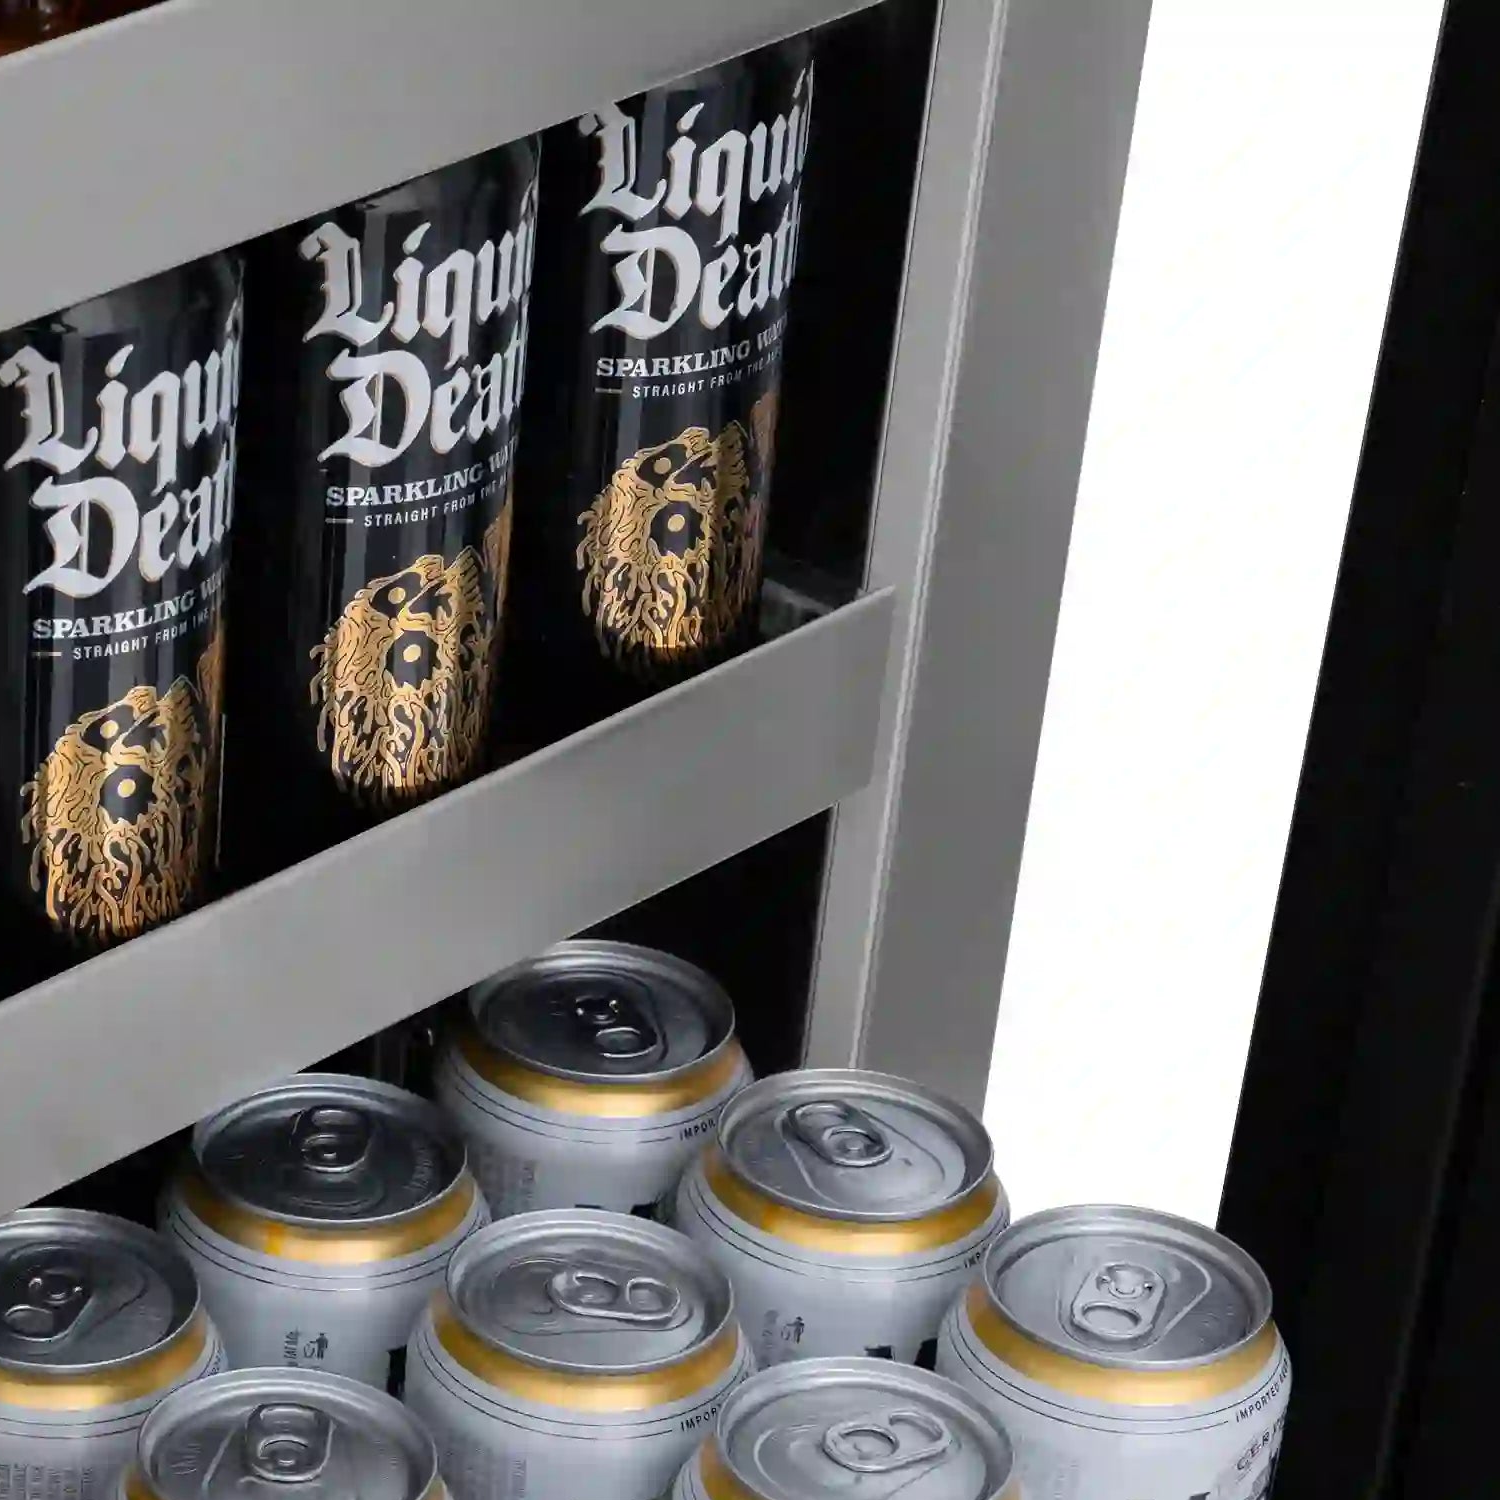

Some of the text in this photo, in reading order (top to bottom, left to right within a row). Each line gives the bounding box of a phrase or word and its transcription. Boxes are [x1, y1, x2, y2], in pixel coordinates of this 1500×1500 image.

[596, 340, 750, 377] SPARKLING
[633, 379, 705, 398] STRAIGHT
[711, 368, 742, 388] FROM
[326, 462, 483, 507] SPARKLING
[364, 506, 438, 528] STRAIGHT
[444, 493, 475, 515] FROM
[32, 593, 196, 640] SPARKLING
[73, 635, 148, 659] STRAIGHT
[155, 623, 187, 645] FROM
[679, 1118, 717, 1141] IMPOR
[680, 1403, 721, 1432] IMPOR
[1236, 1382, 1280, 1422] IMPORTED
